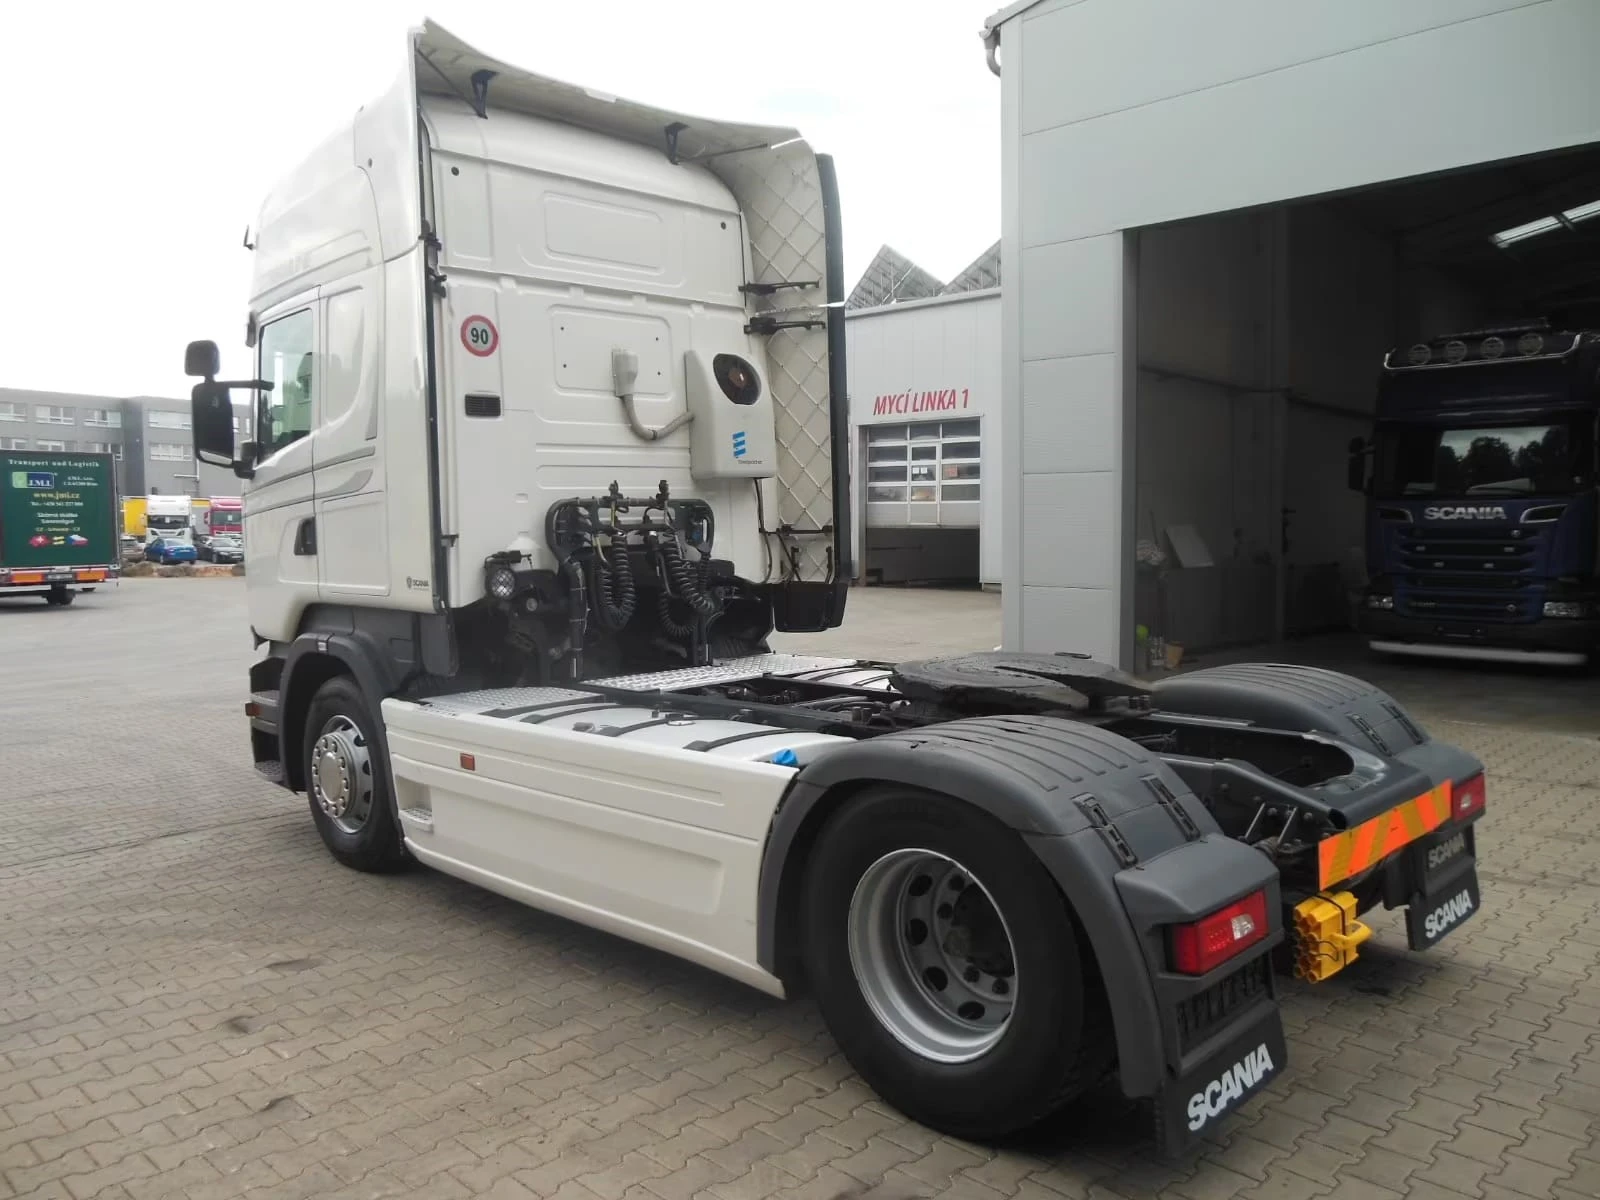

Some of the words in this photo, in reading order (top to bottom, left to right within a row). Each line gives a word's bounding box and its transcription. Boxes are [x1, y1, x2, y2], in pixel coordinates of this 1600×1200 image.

[471, 327, 489, 345] 90
[873, 388, 912, 415] MYCÍ
[911, 388, 957, 413] LINKA
[962, 388, 970, 409] 1
[8, 459, 49, 467] Transport
[68, 460, 100, 468] Logistik
[1424, 506, 1507, 520] SCANIA
[1428, 832, 1465, 869] SCANIA
[1424, 889, 1473, 939] SCANIA
[1187, 1042, 1275, 1132] SCANIA
